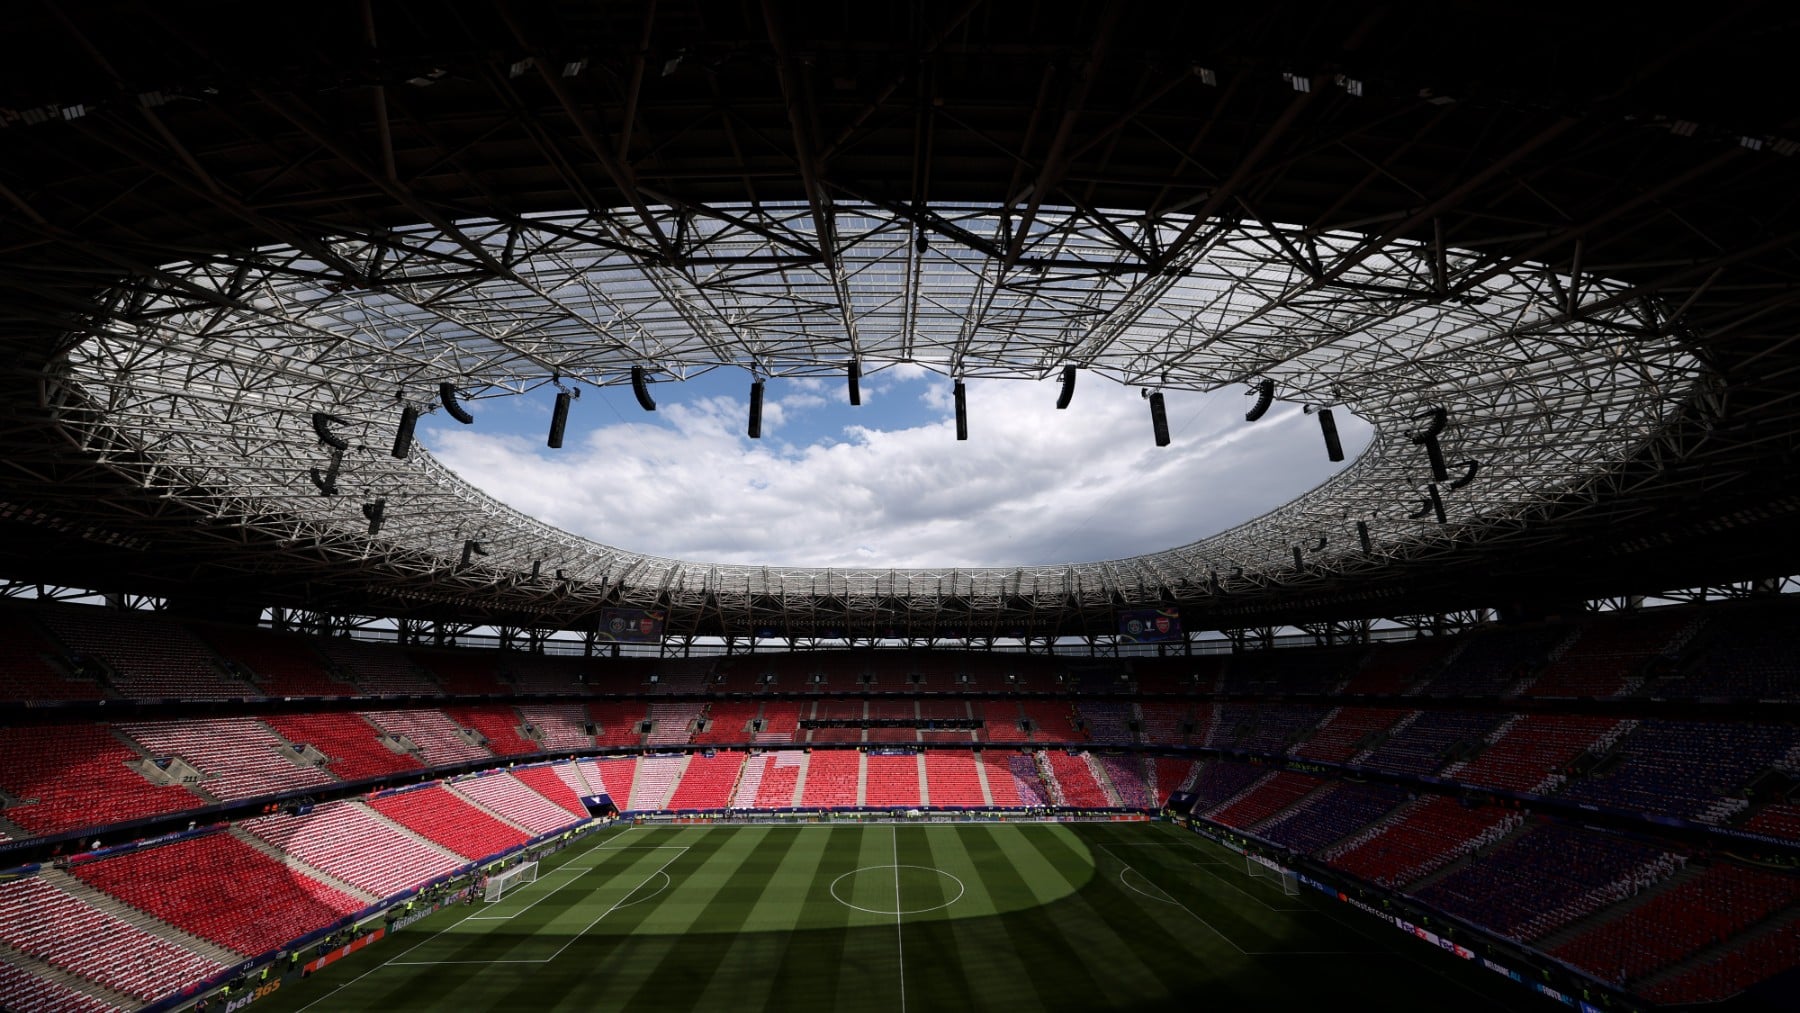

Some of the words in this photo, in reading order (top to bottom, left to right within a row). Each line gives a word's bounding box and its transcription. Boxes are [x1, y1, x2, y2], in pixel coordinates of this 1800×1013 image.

[183, 775, 198, 784] 211
[391, 906, 433, 934] Heineken
[1348, 897, 1395, 924] mastercard
[225, 978, 281, 1013] bet365
